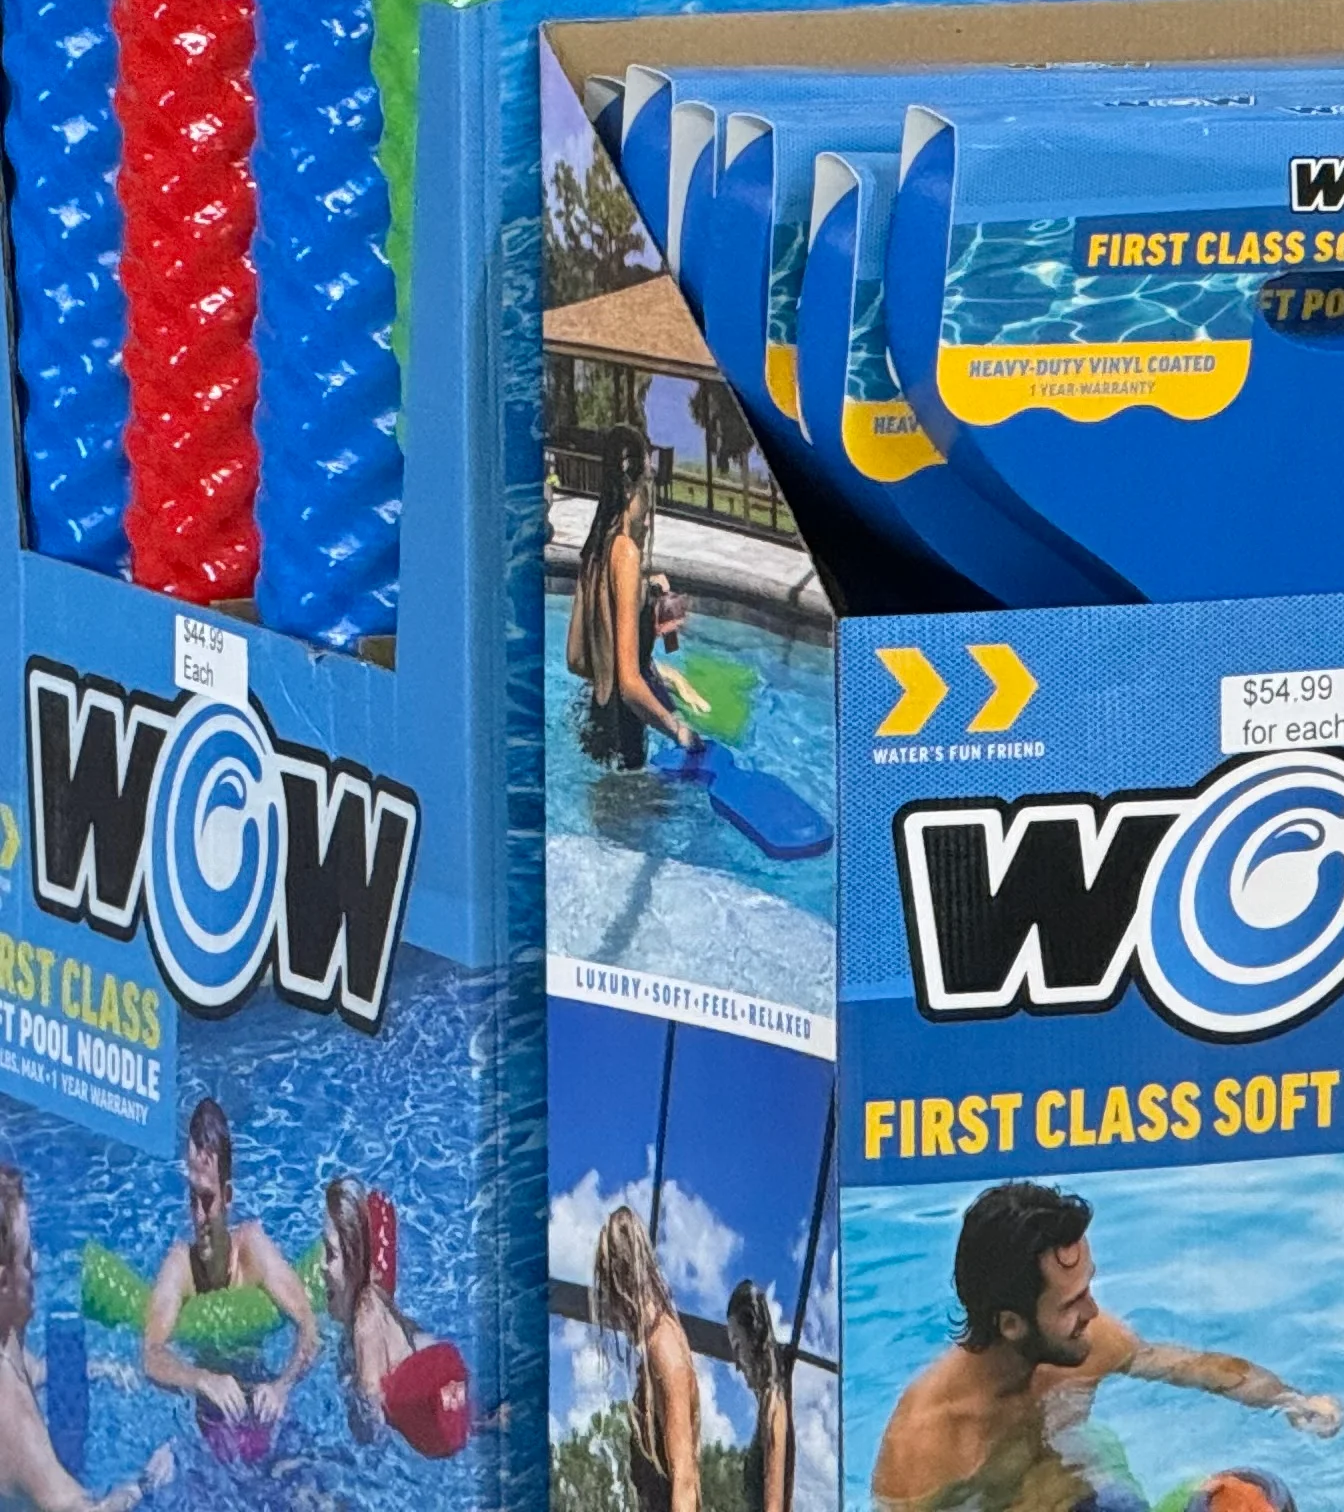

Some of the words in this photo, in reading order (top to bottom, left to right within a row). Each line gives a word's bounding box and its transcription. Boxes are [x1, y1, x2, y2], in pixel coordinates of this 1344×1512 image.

[1087, 230, 1189, 267] FIRST
[1196, 228, 1305, 265] CLASS
[969, 355, 1087, 379] HEAVY-DUTY
[1090, 354, 1142, 377] VINYL
[1147, 352, 1216, 375] COATED
[183, 617, 224, 655] $44.99
[183, 657, 214, 688] Each
[1242, 674, 1334, 708] $54.99
[1242, 717, 1279, 746] for
[873, 746, 945, 765] WATER'S
[949, 743, 982, 762] FUN
[987, 741, 1046, 759] FRIEND
[26, 655, 422, 1036] WOW
[61, 958, 161, 1050] CLASS
[576, 966, 641, 999] LUXURY
[652, 982, 691, 1010] SOFT
[703, 992, 738, 1021] FEEL
[749, 1004, 811, 1040] RELAXED
[20, 1008, 73, 1067] POOL
[77, 1029, 161, 1103] NOODLE
[62, 1073, 88, 1102] YEAR
[90, 1084, 150, 1126] WARRANTY
[865, 1094, 1023, 1161] FIRST
[1036, 1082, 1200, 1148] CLASS
[1213, 1070, 1339, 1136] SOFT
